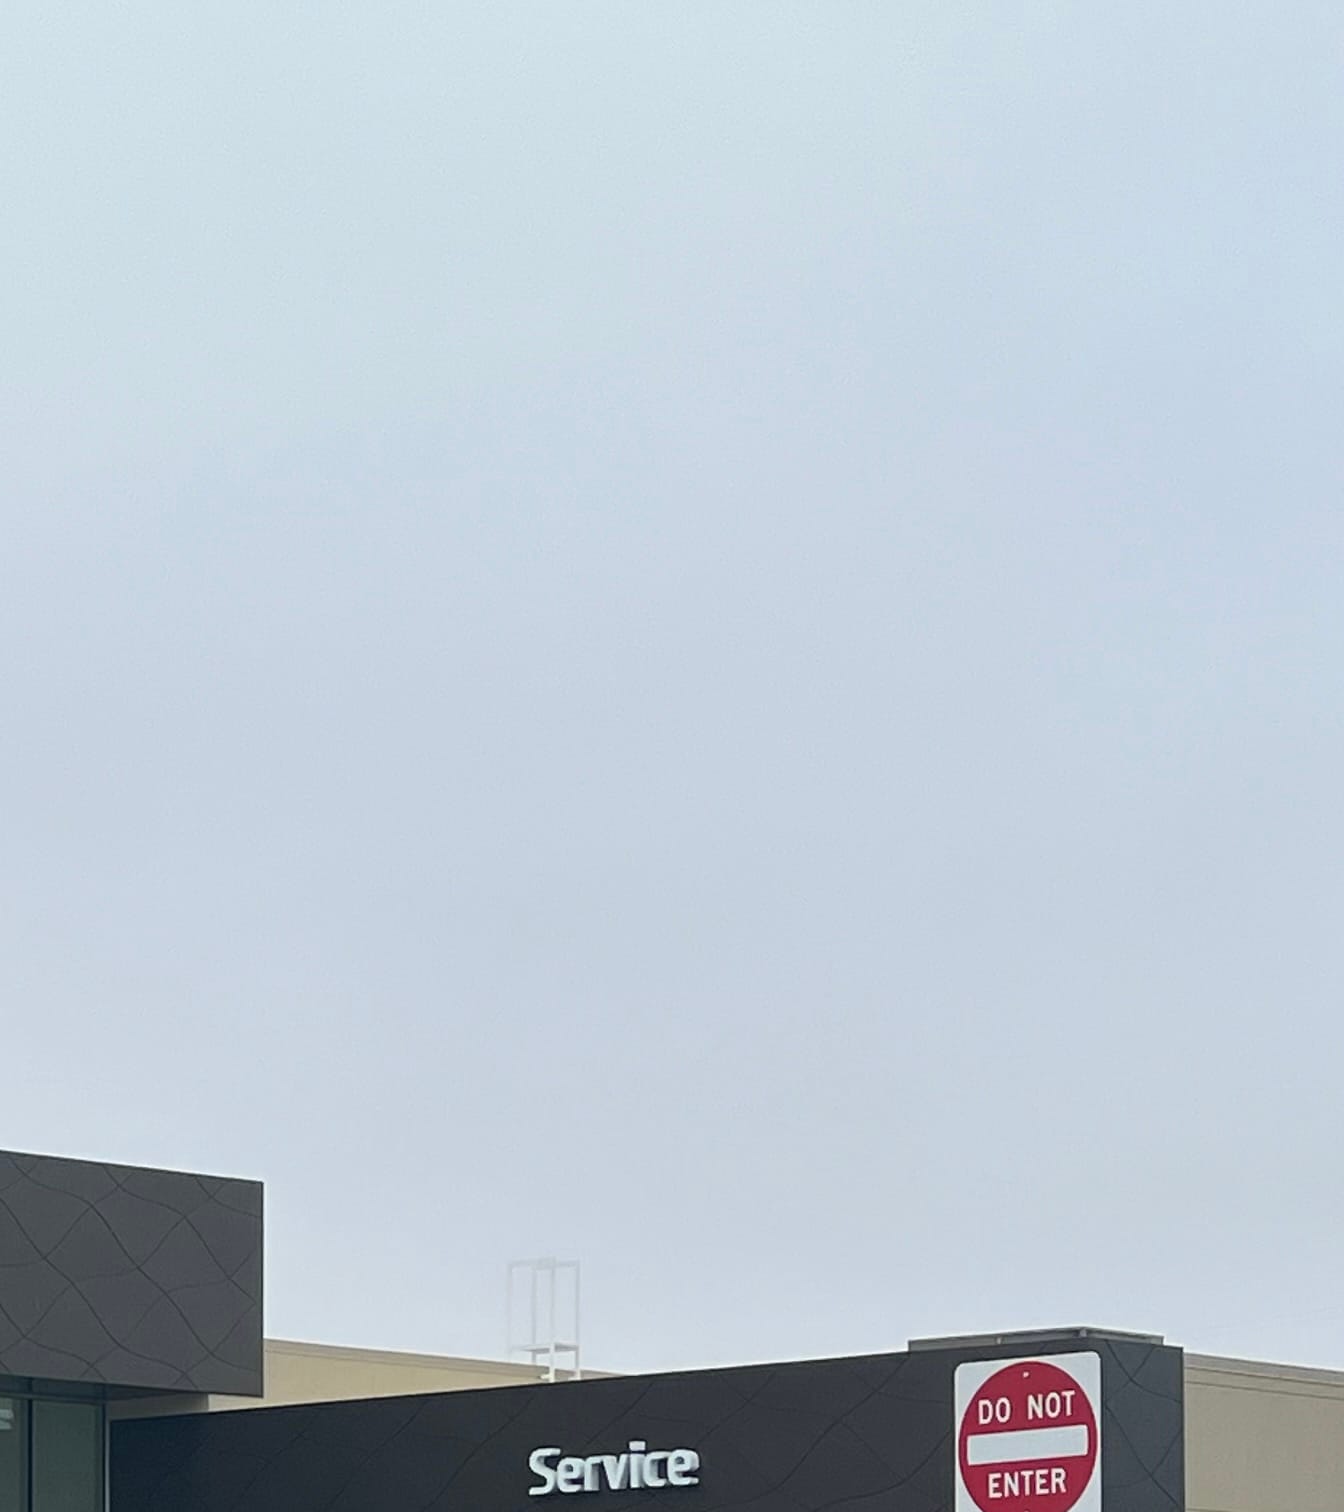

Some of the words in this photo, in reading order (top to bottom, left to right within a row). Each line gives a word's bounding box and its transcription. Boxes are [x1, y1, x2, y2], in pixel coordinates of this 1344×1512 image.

[978, 1397, 1011, 1425] DO
[1027, 1390, 1076, 1420] NOT
[528, 1440, 700, 1496] Service
[988, 1467, 1067, 1499] ENTER
